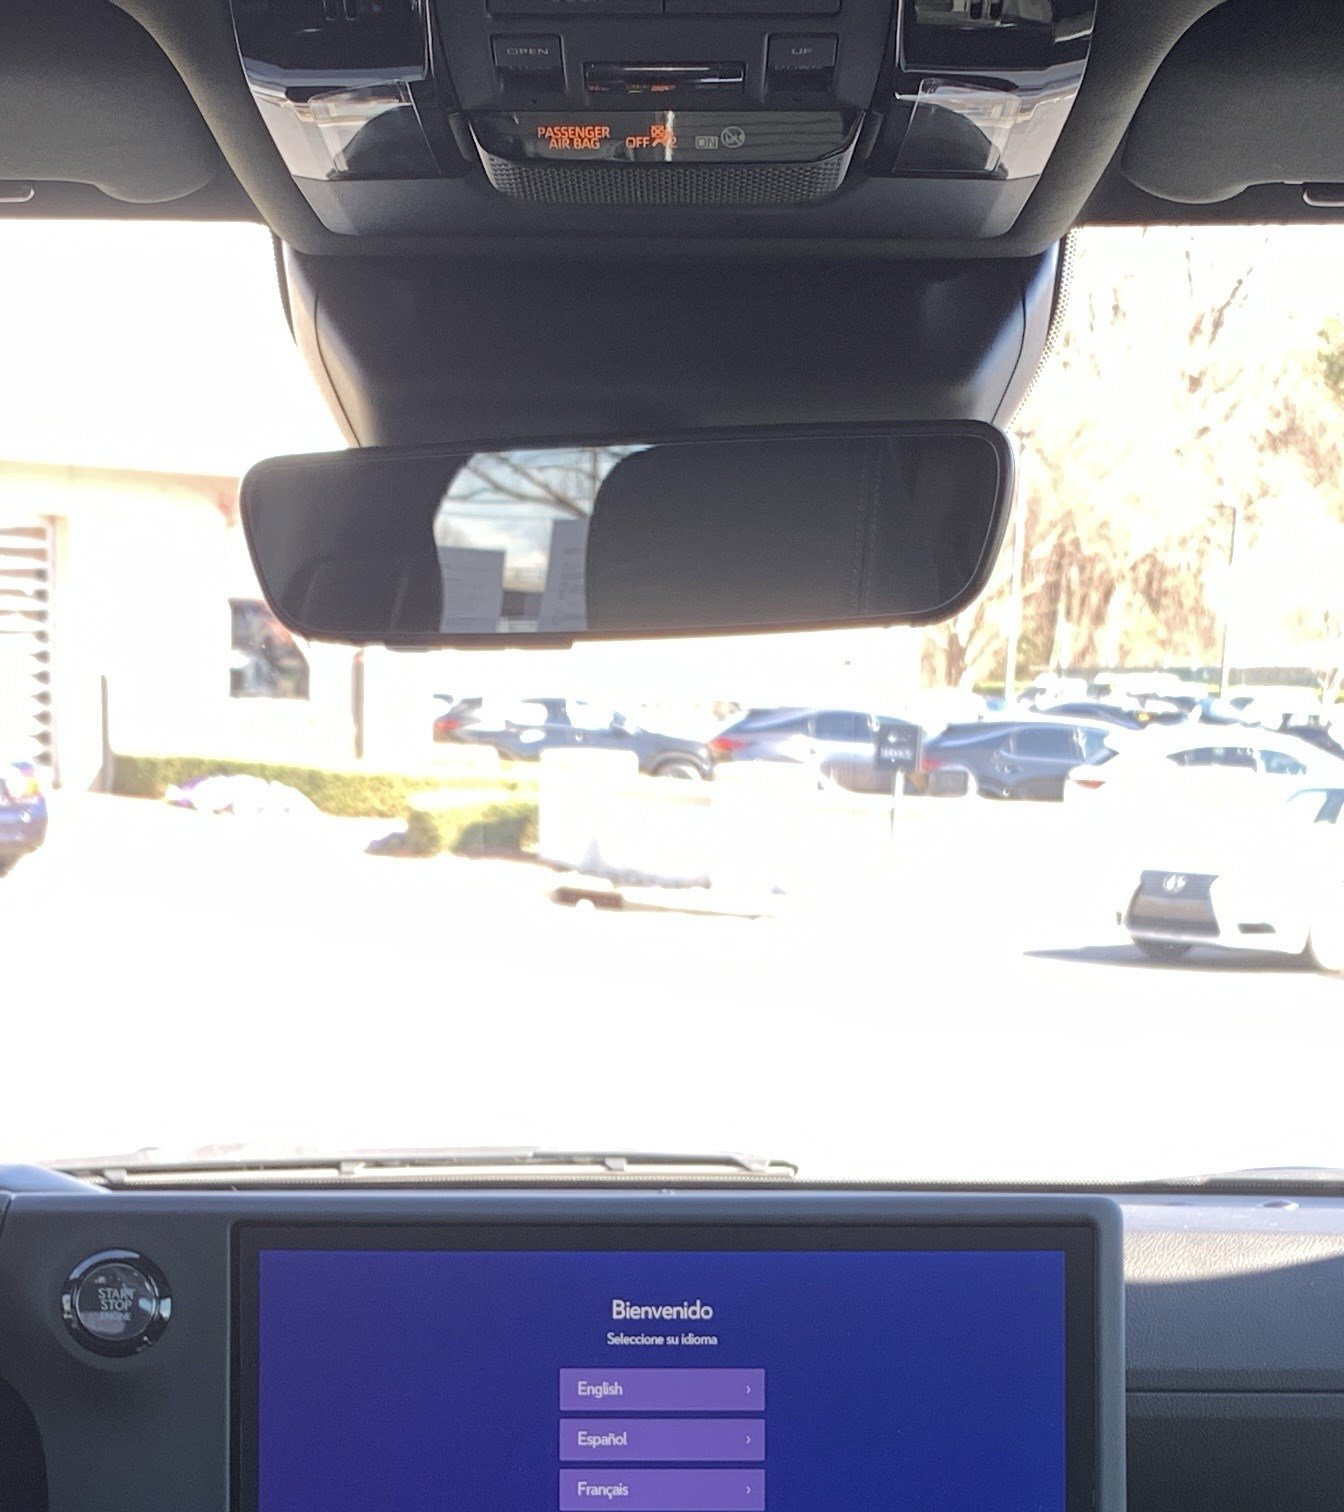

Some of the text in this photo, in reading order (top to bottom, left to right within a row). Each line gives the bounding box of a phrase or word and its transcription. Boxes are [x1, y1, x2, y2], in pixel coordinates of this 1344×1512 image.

[506, 47, 549, 55] OPEN
[790, 47, 813, 55] UP
[537, 126, 610, 139] PASSENGER
[548, 138, 601, 150] AIR BAG
[625, 137, 717, 149] OFF ON
[98, 1287, 136, 1300] START
[100, 1300, 133, 1311] STOP
[611, 1299, 714, 1321] Bienvenido
[606, 1332, 719, 1346] Seleccione su idioma
[577, 1381, 624, 1398] English
[577, 1430, 628, 1449] Español
[577, 1480, 630, 1500] Français
